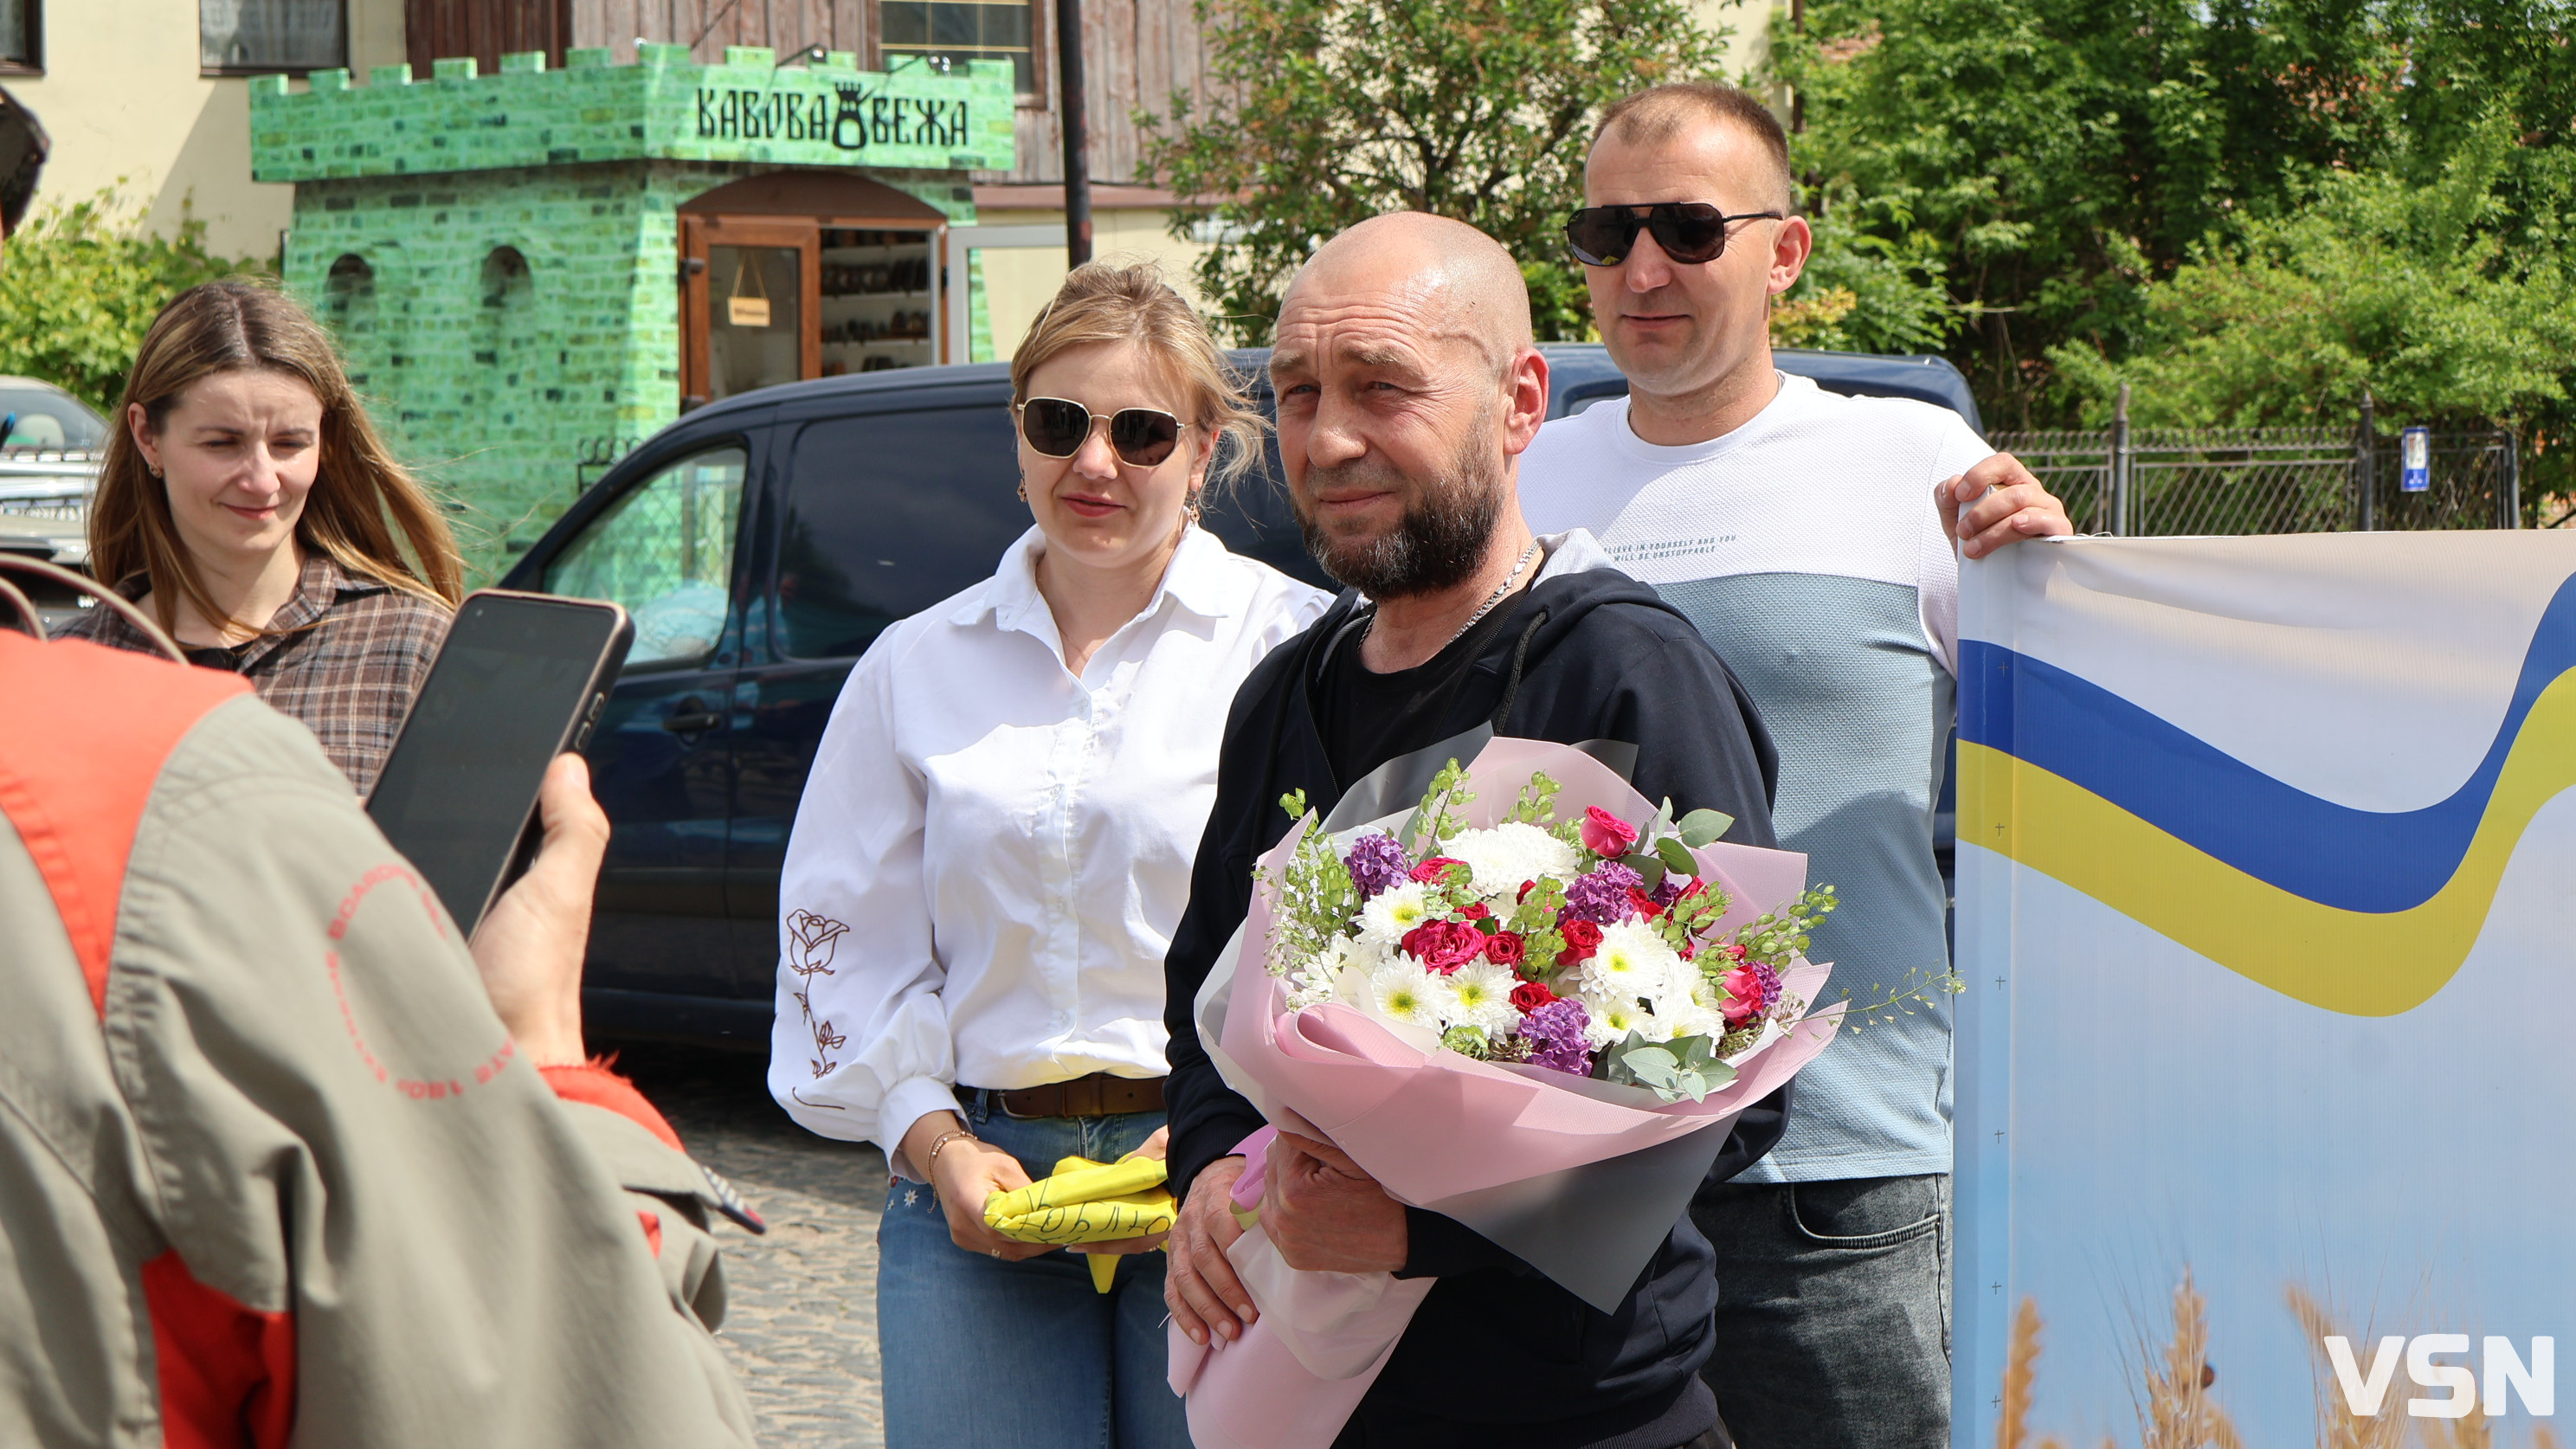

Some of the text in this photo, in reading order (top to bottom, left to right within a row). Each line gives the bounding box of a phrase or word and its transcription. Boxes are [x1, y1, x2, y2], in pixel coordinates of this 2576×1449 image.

[697, 87, 968, 146] КАВОВА ВЕЖА
[1603, 544, 1633, 554] ELIEVE
[1650, 539, 1694, 551] YOURSELF
[1697, 537, 1715, 546] AND
[1719, 534, 1736, 544] YOU
[1613, 545, 1716, 563] WILL BE UNSTOPPABLE
